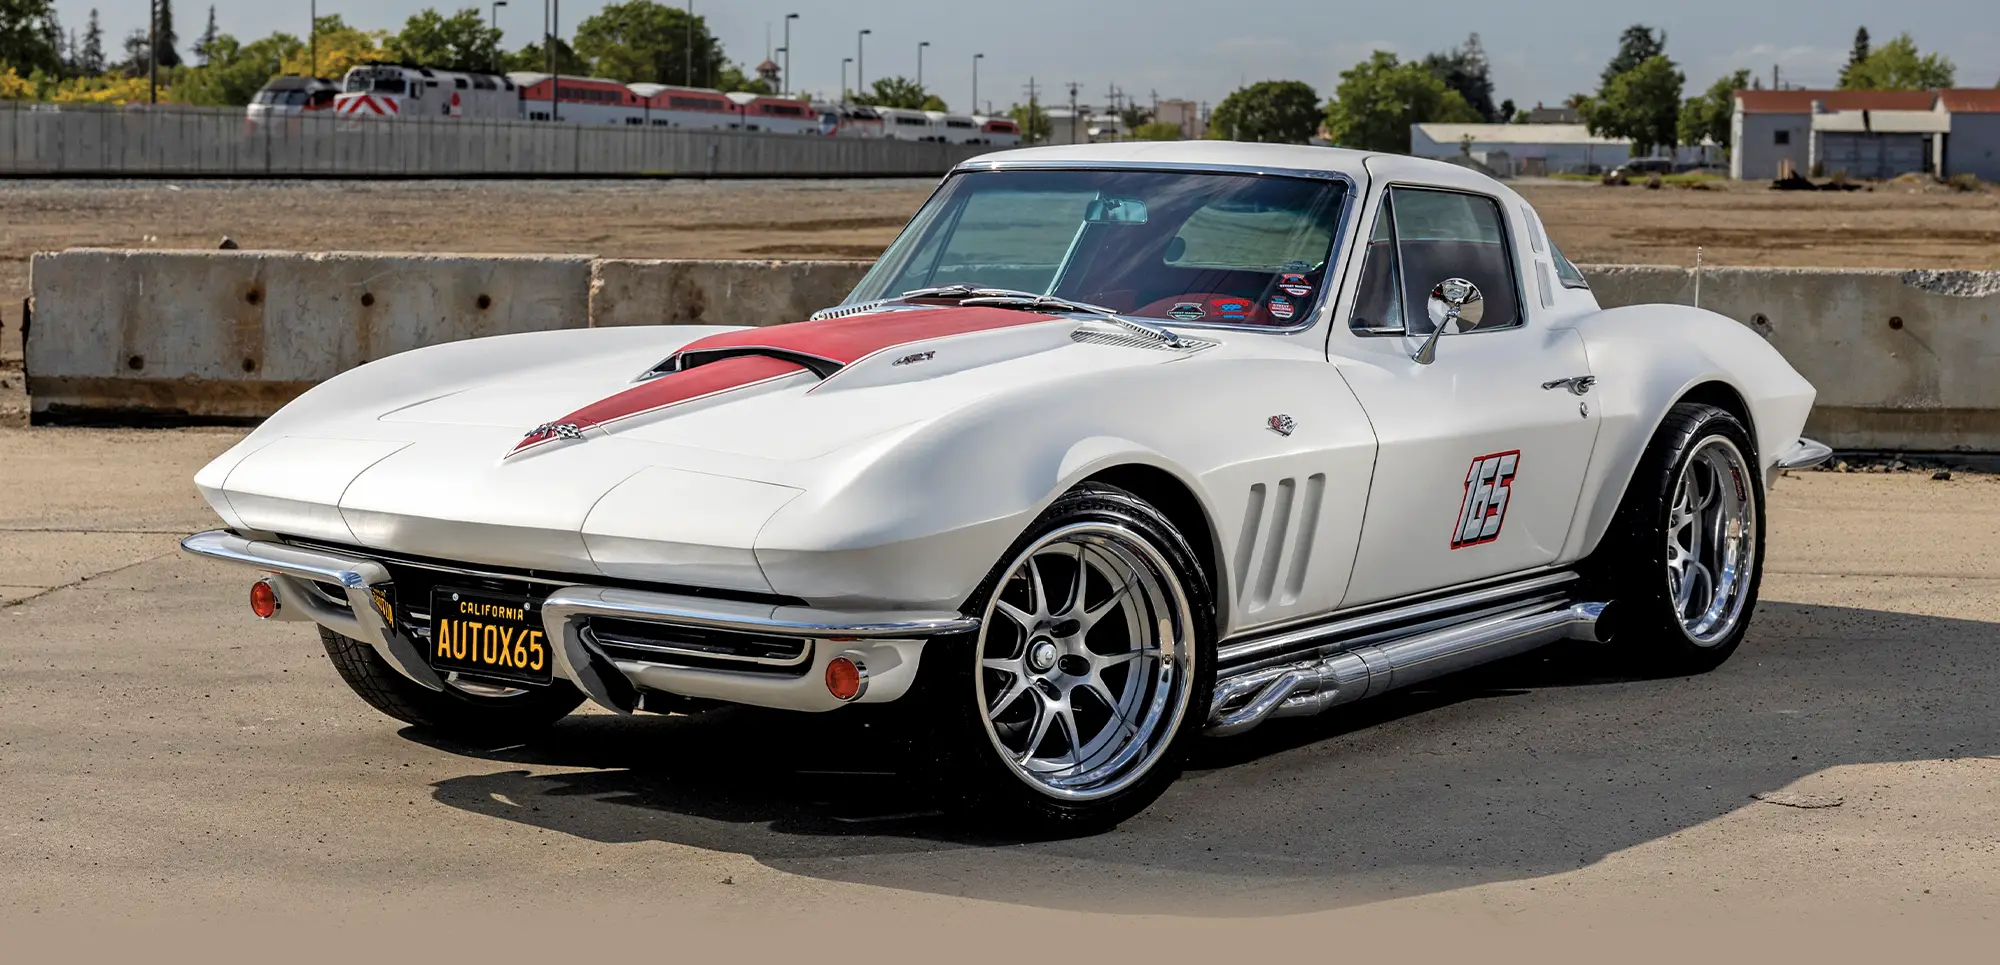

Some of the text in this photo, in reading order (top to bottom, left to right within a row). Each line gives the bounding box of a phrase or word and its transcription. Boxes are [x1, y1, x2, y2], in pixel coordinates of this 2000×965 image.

[1451, 450, 1520, 549] 165
[460, 601, 524, 621] CALIFORNIA
[437, 618, 544, 671] AUTOX65
